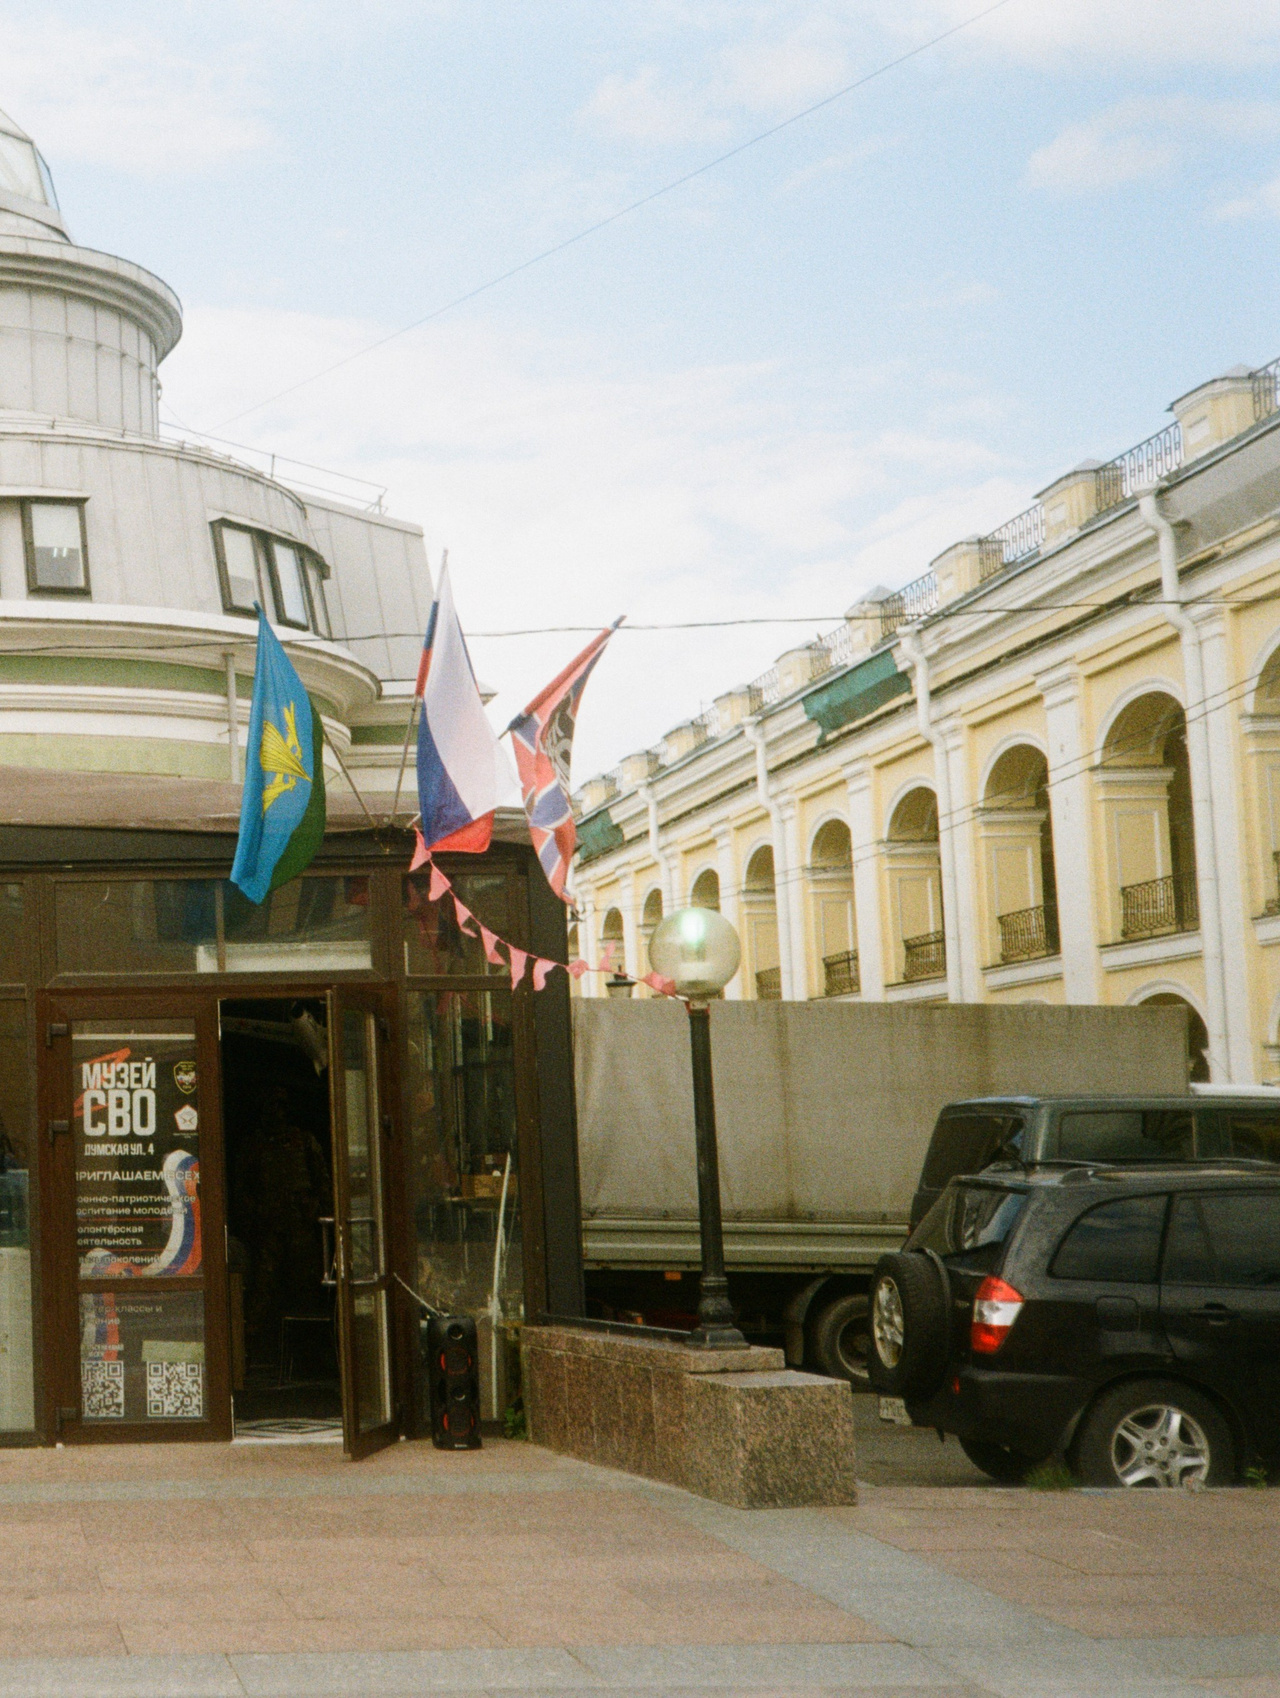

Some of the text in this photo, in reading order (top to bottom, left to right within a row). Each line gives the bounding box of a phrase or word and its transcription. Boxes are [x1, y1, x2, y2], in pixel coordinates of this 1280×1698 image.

[82, 1057, 156, 1089] МУЗЕЙ
[83, 1089, 156, 1136] СВО
[84, 1143, 129, 1156] ДУМСКАЯ
[147, 1143, 154, 1155] 4
[76, 1207, 131, 1216] оспитание
[77, 1225, 144, 1235] олонтёрская
[77, 1237, 142, 1246] еятельность
